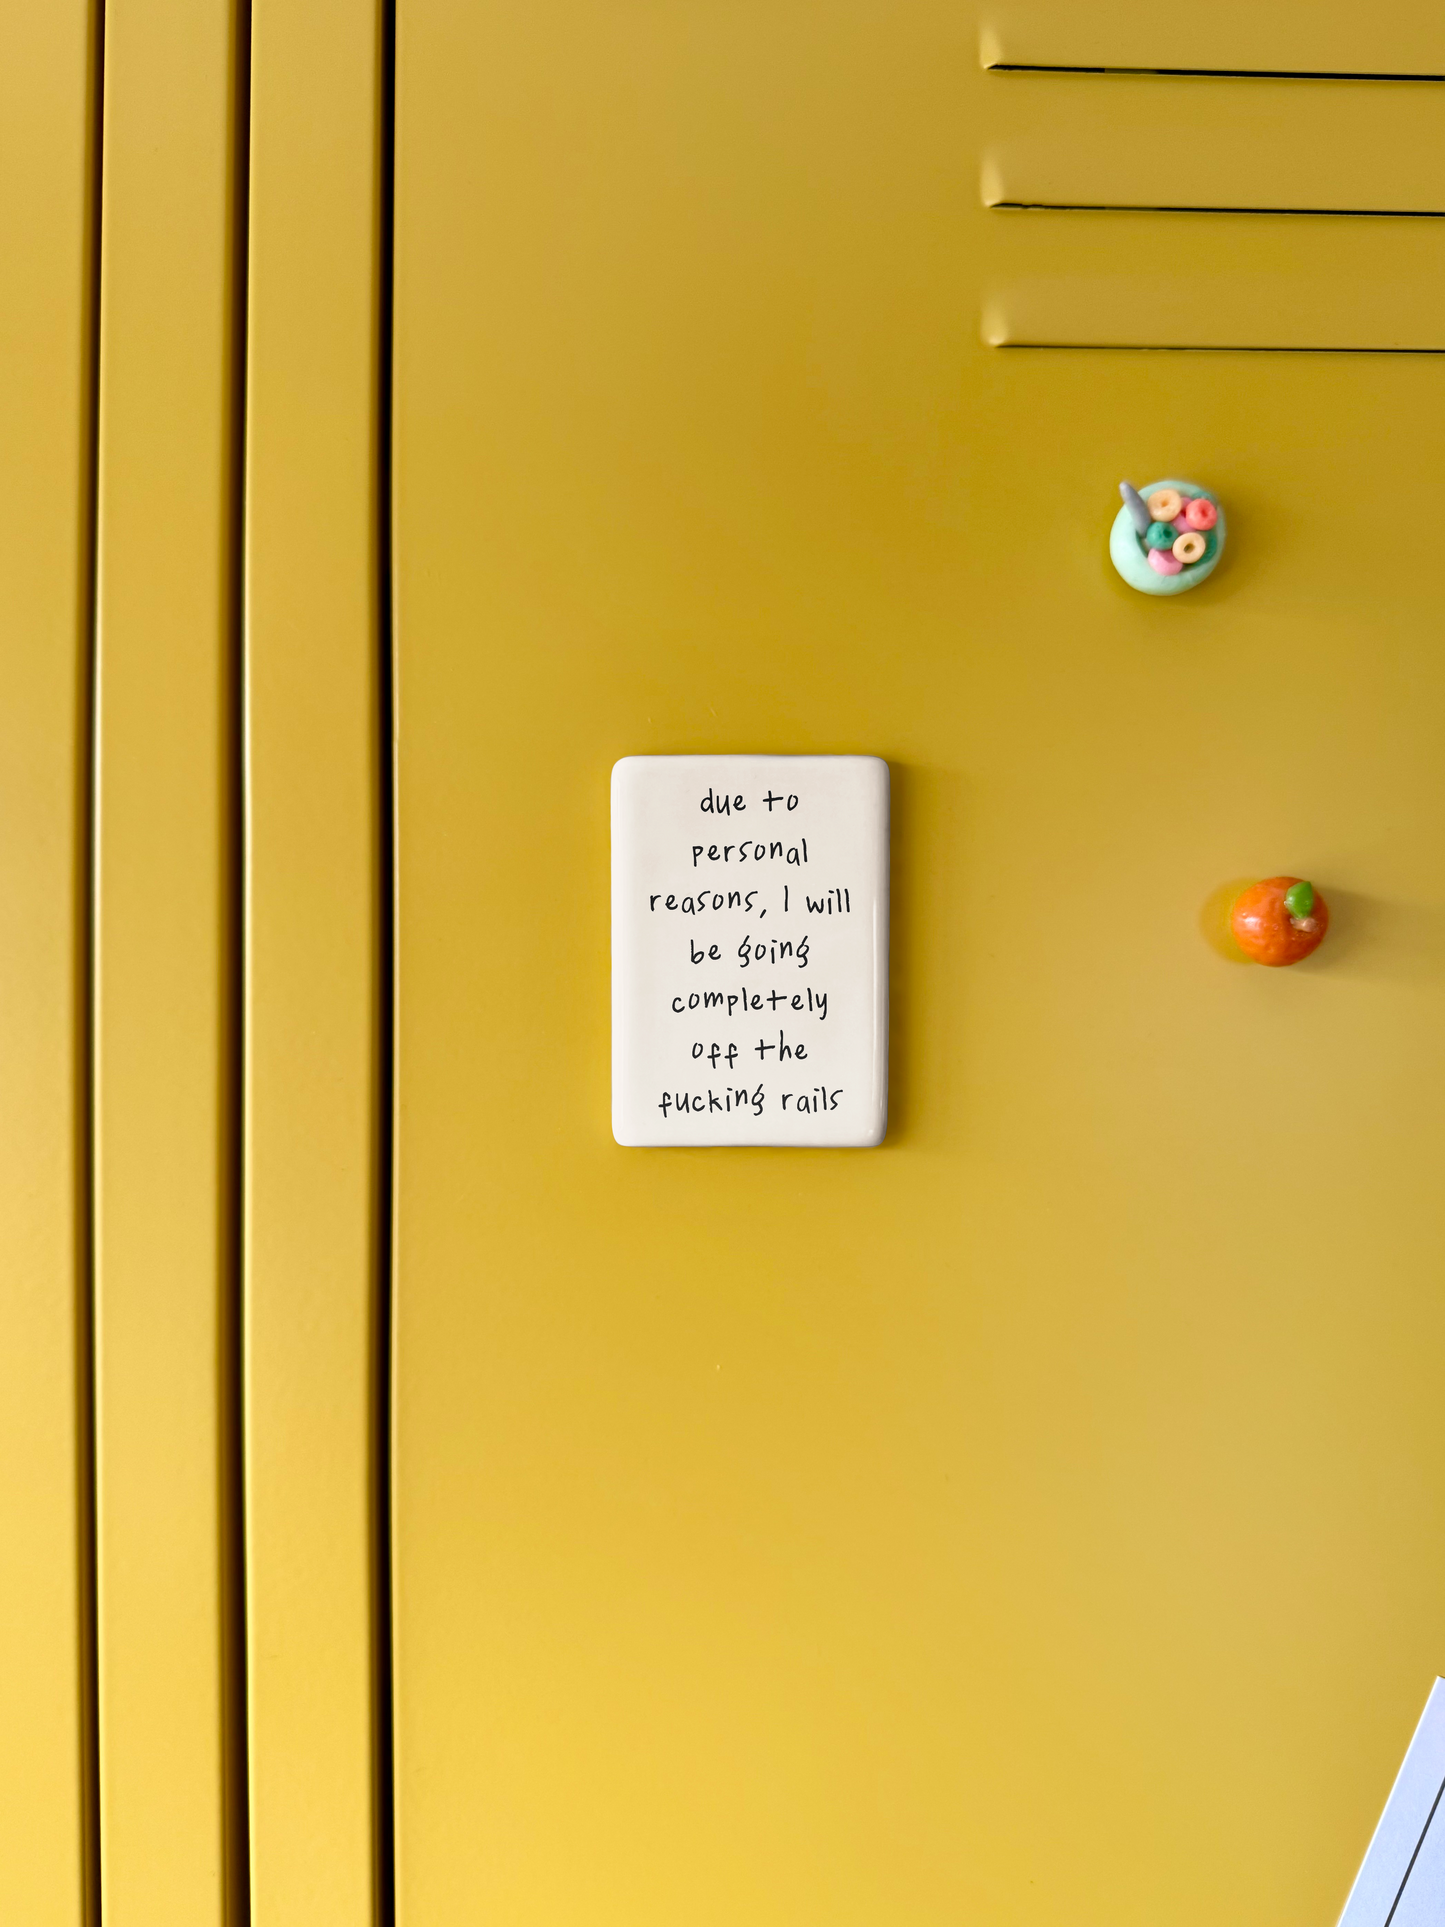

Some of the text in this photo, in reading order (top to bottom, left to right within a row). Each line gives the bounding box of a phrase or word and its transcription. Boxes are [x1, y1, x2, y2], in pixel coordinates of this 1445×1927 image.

[700, 787, 799, 816] due to
[692, 837, 808, 867] personal
[649, 884, 851, 919] reasons, I will
[690, 934, 810, 969] be going
[671, 986, 828, 1021] completely
[691, 1029, 808, 1070] off the
[658, 1083, 844, 1119] fucking rails
